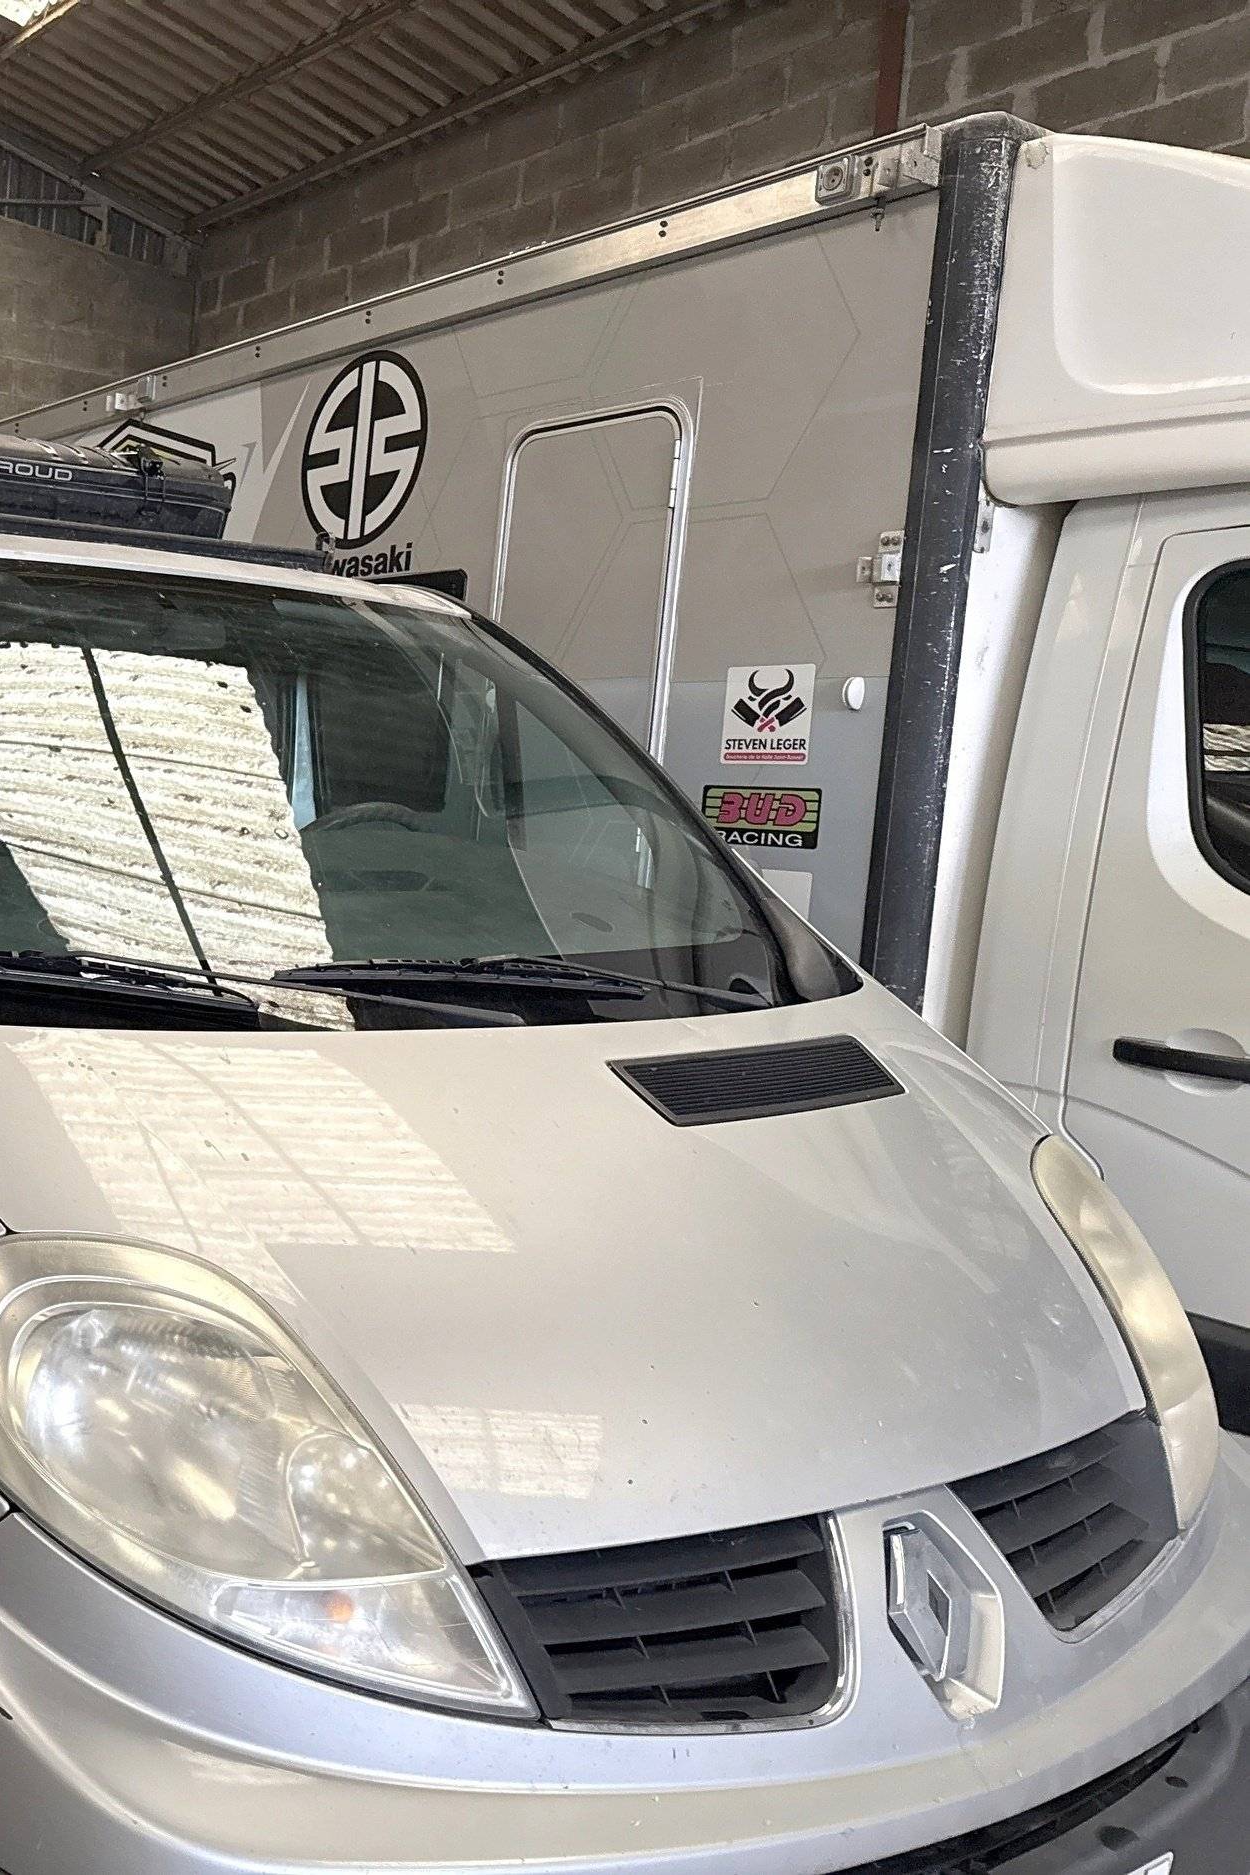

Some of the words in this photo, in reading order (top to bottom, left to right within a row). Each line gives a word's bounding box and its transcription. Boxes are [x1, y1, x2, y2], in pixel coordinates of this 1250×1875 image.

[333, 542, 413, 578] wasaki
[724, 738, 767, 751] STEVEN
[770, 739, 807, 751] LEGER
